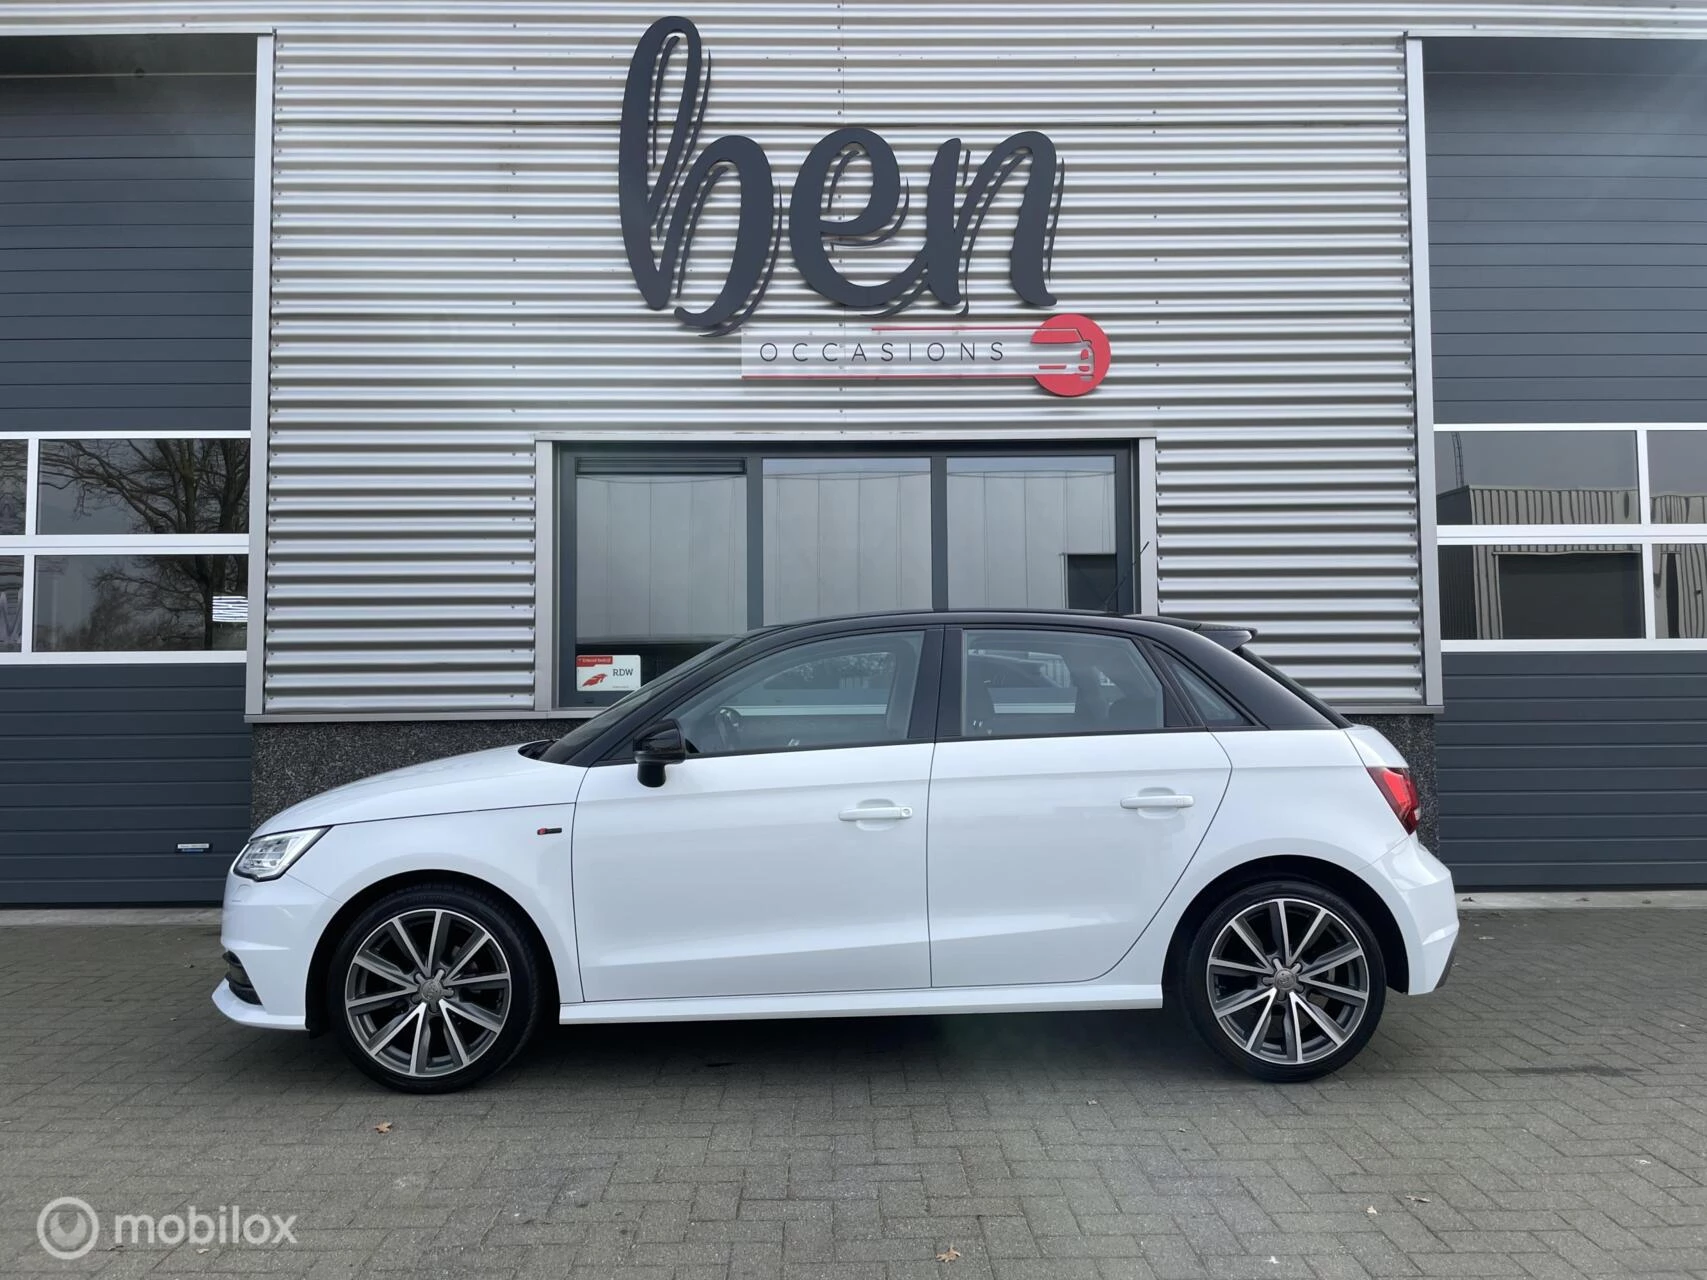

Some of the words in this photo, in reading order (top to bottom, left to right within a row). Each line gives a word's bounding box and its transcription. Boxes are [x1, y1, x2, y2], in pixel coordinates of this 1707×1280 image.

[618, 15, 1064, 337] ben
[759, 341, 1005, 363] OCCASIONS
[612, 668, 634, 677] RDW
